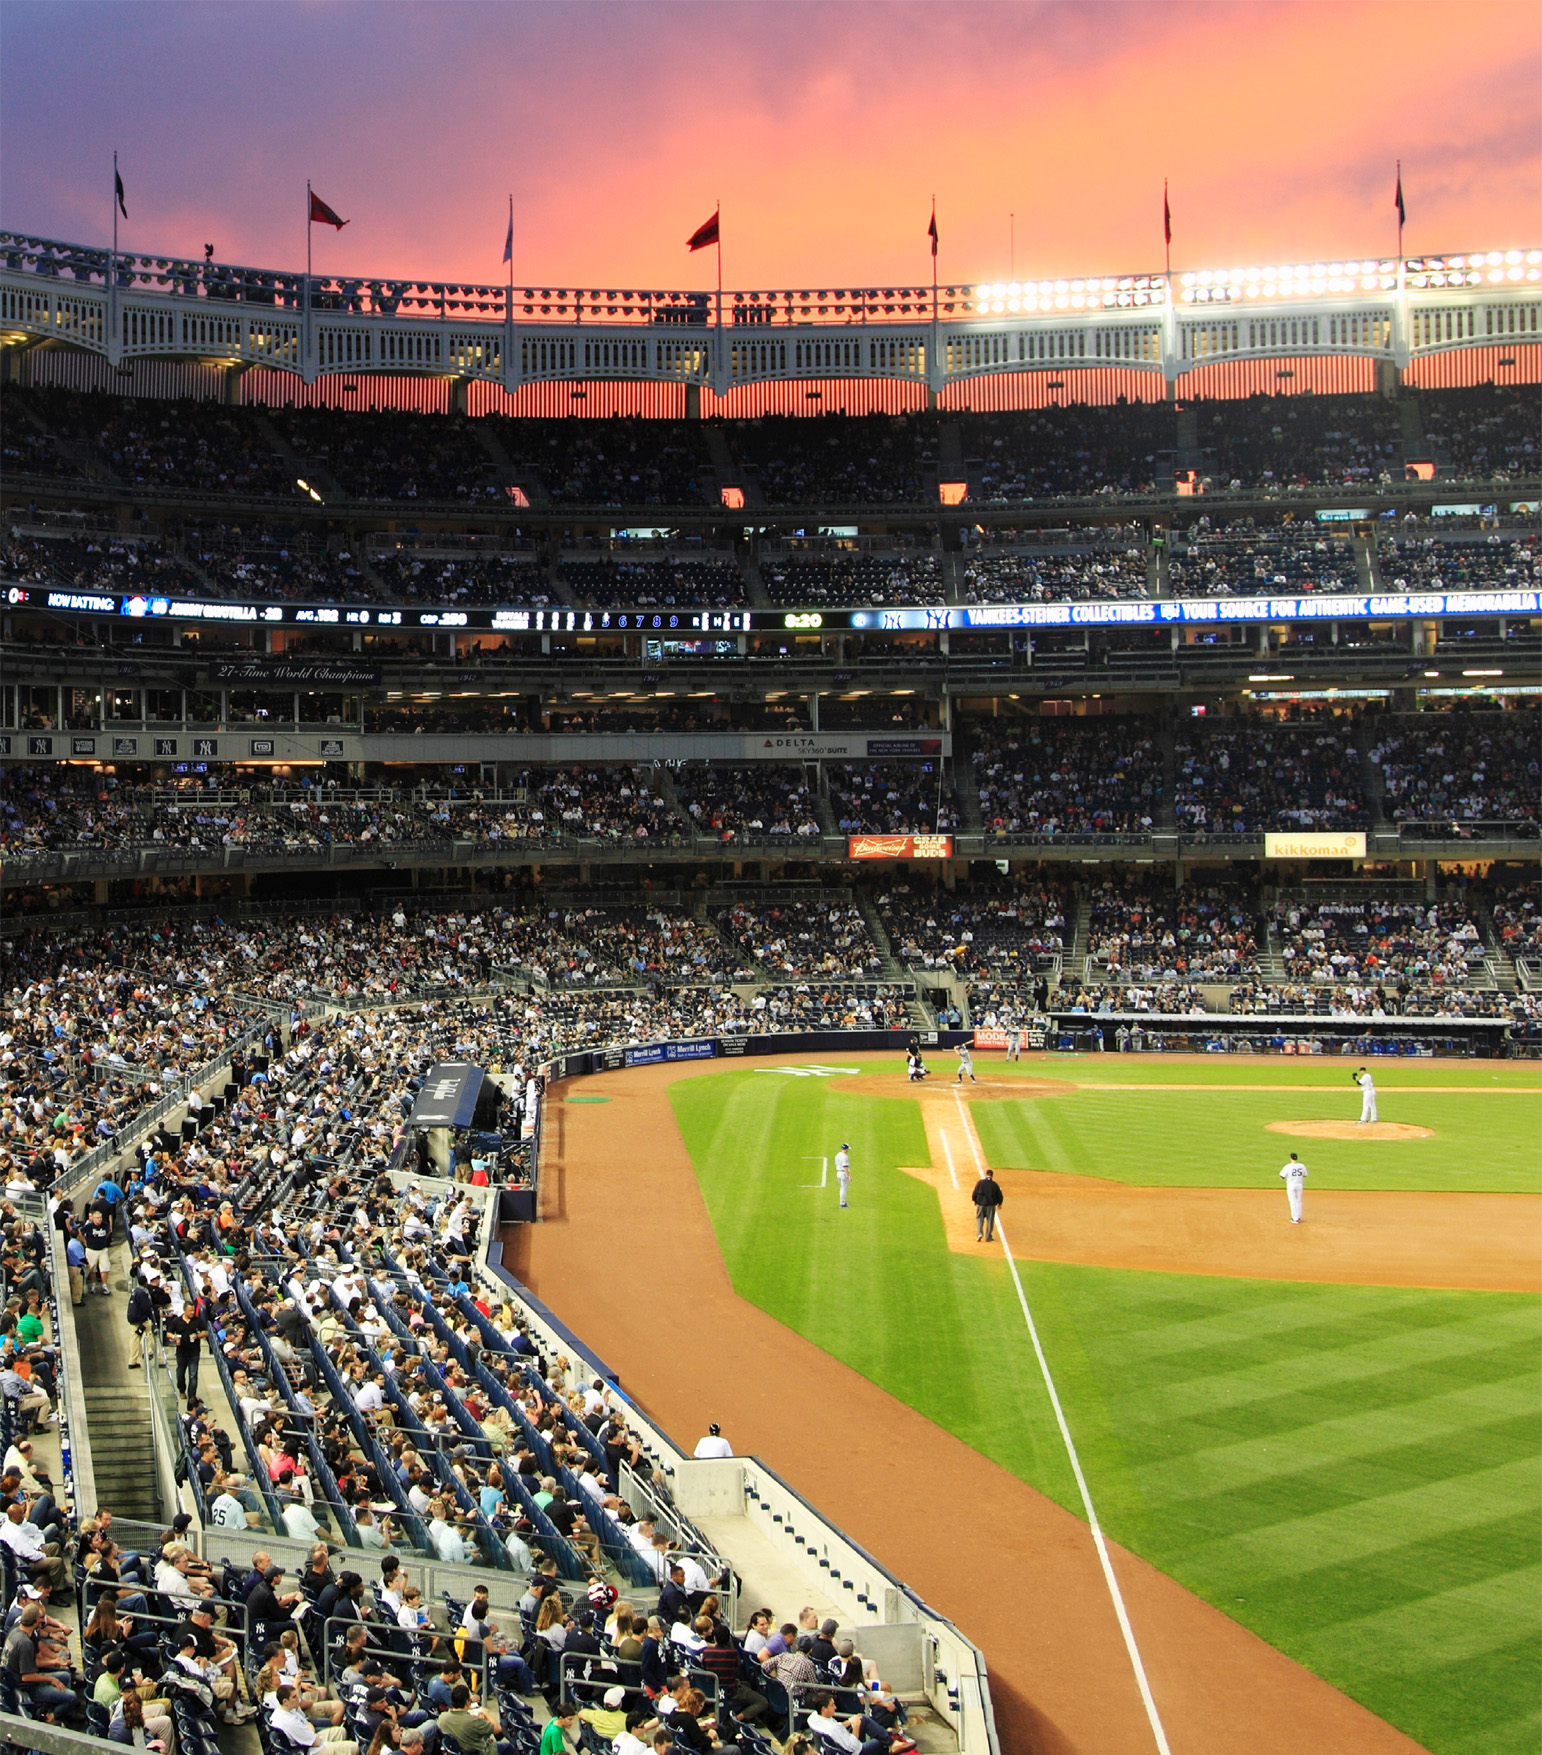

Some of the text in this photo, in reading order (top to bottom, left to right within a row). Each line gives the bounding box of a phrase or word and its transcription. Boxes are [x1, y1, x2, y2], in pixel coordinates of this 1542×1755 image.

[1182, 603, 1217, 619] YOUR
[1219, 601, 1269, 619] SOURCE
[1270, 600, 1297, 618] FOR
[1298, 598, 1368, 617] AUTHENTIC
[1370, 596, 1444, 614] GAME-USED
[1446, 593, 1537, 612] MEMORABILIA
[1072, 604, 1155, 622] COLLECTIBLES
[618, 615, 627, 628] 6
[636, 615, 645, 628] 7
[652, 615, 661, 628] 8
[670, 615, 679, 628] 9
[713, 617, 722, 627] H
[784, 613, 823, 629] 8:20
[217, 665, 375, 683] 27-Time World Champions
[776, 739, 815, 747] DELTA
[827, 747, 848, 755] SUITE
[913, 836, 947, 844] GRAB
[853, 841, 906, 854] Budweiser
[1275, 844, 1349, 855] kikkoman
[913, 849, 946, 858] BUDS
[634, 1050, 648, 1058] Merrill
[648, 1047, 661, 1056] Lynch
[677, 1044, 695, 1054] Merrill
[695, 1043, 711, 1052] Lynch
[1291, 1168, 1303, 1177] 25
[256, 1622, 265, 1634] NY
